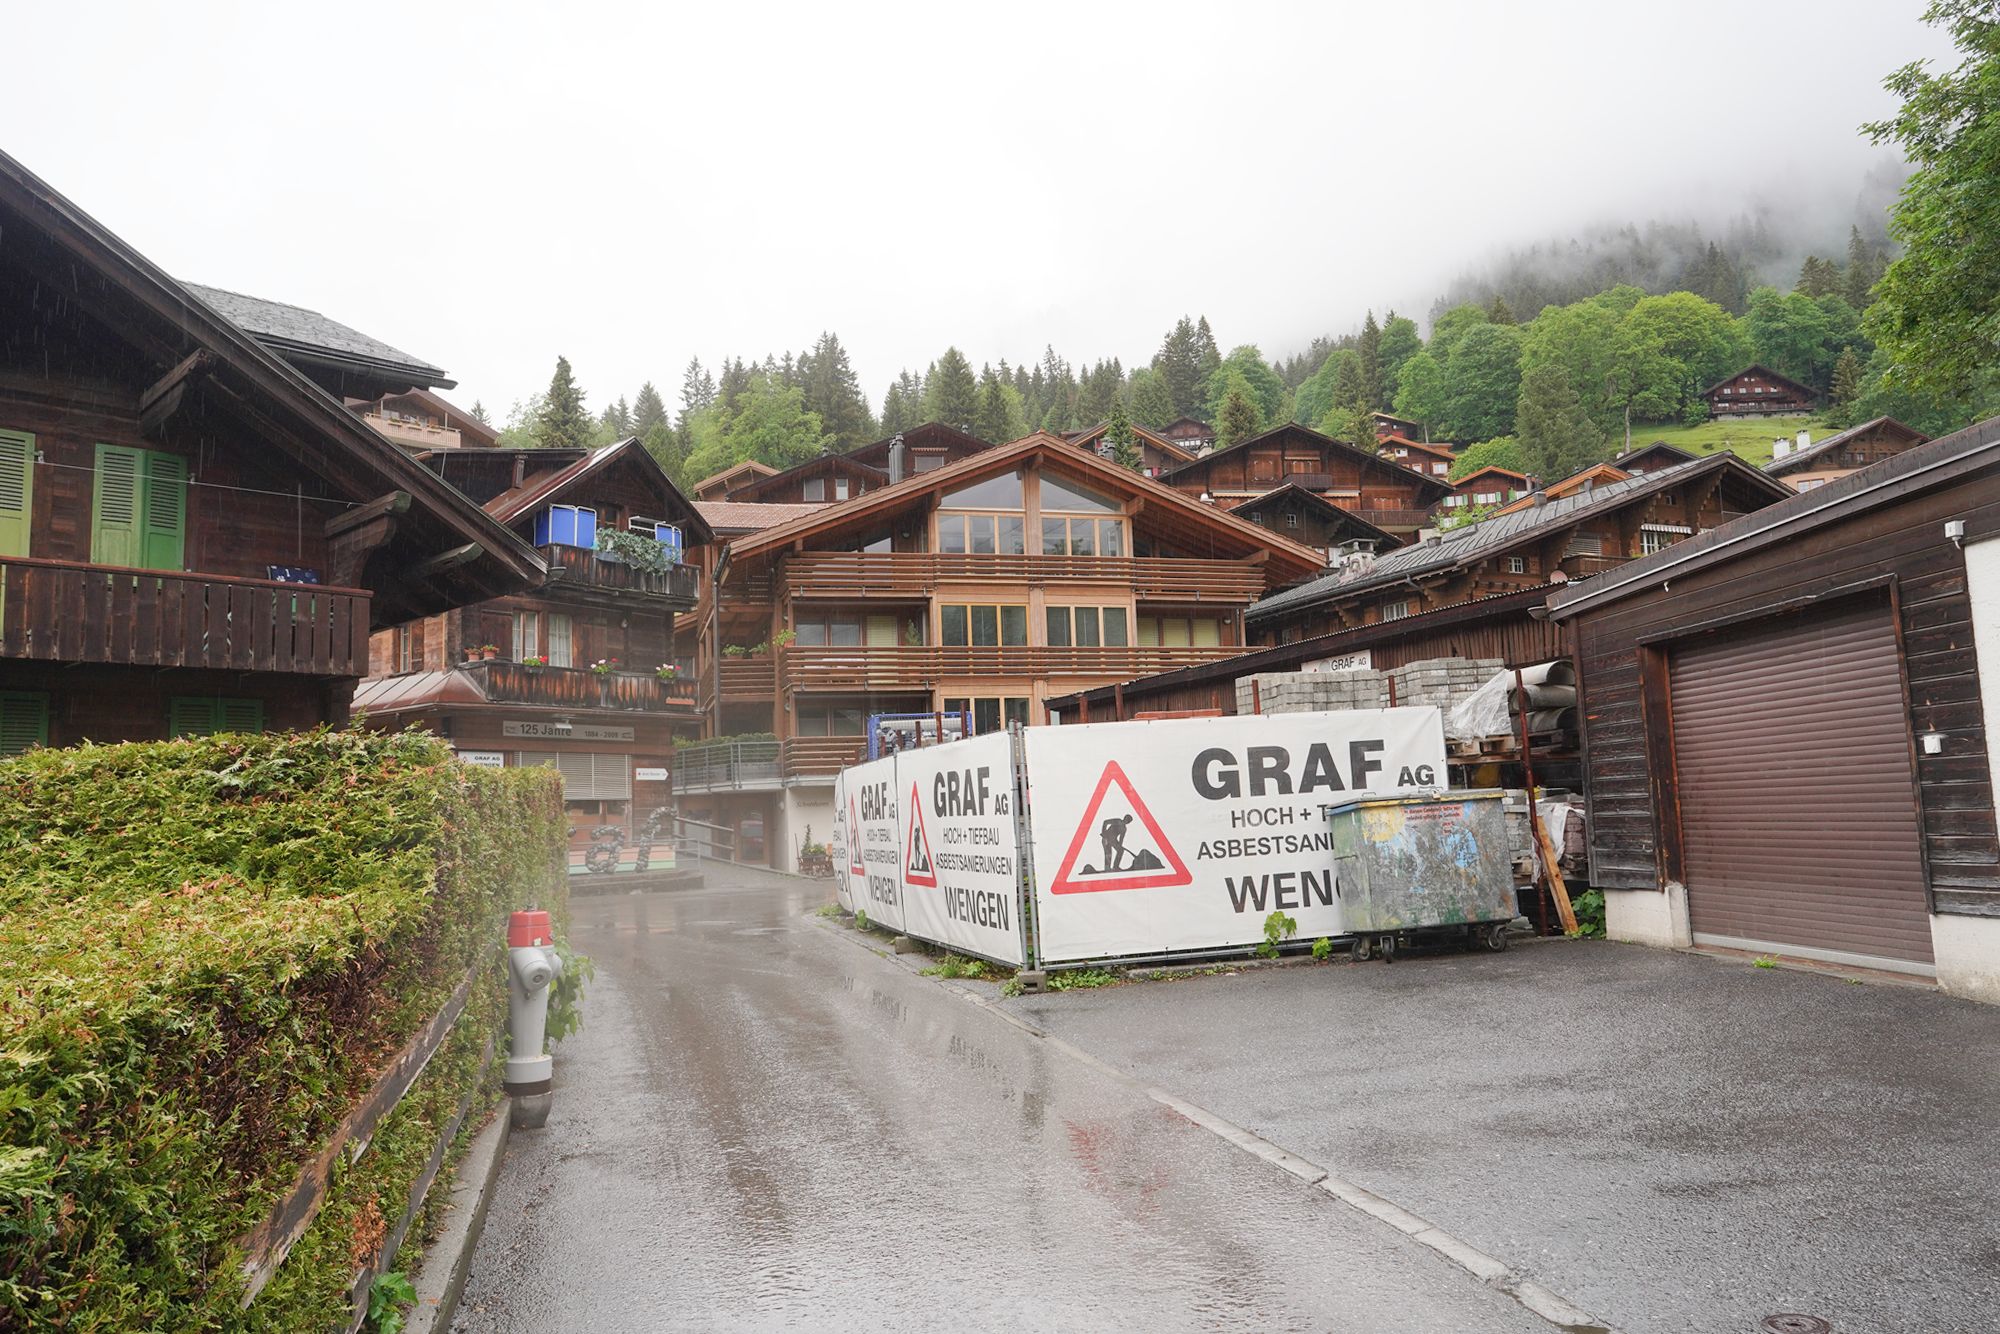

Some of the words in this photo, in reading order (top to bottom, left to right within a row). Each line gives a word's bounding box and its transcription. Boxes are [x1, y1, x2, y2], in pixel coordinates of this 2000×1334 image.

[1331, 656, 1355, 671] GRAF
[1359, 657, 1367, 666] AG
[520, 724, 539, 735] 125
[1192, 739, 1385, 800] GRAF
[1397, 764, 1435, 787] AG
[861, 782, 887, 821] GRAF
[889, 803, 895, 819] AG
[934, 766, 990, 818] GRAF
[995, 793, 1009, 816] AG
[1231, 806, 1294, 828] HOCH
[1300, 808, 1311, 820] +
[1316, 804, 1329, 821] T
[943, 828, 961, 844] HOCH
[968, 828, 1000, 845] TIEFBAU
[1197, 832, 1335, 860] ASBESTSANI
[936, 853, 1012, 876] ASBESTSANIERUNGEN
[869, 874, 897, 907] WENGEN
[1224, 869, 1341, 914] WEN
[944, 885, 1010, 931] WENGEN
